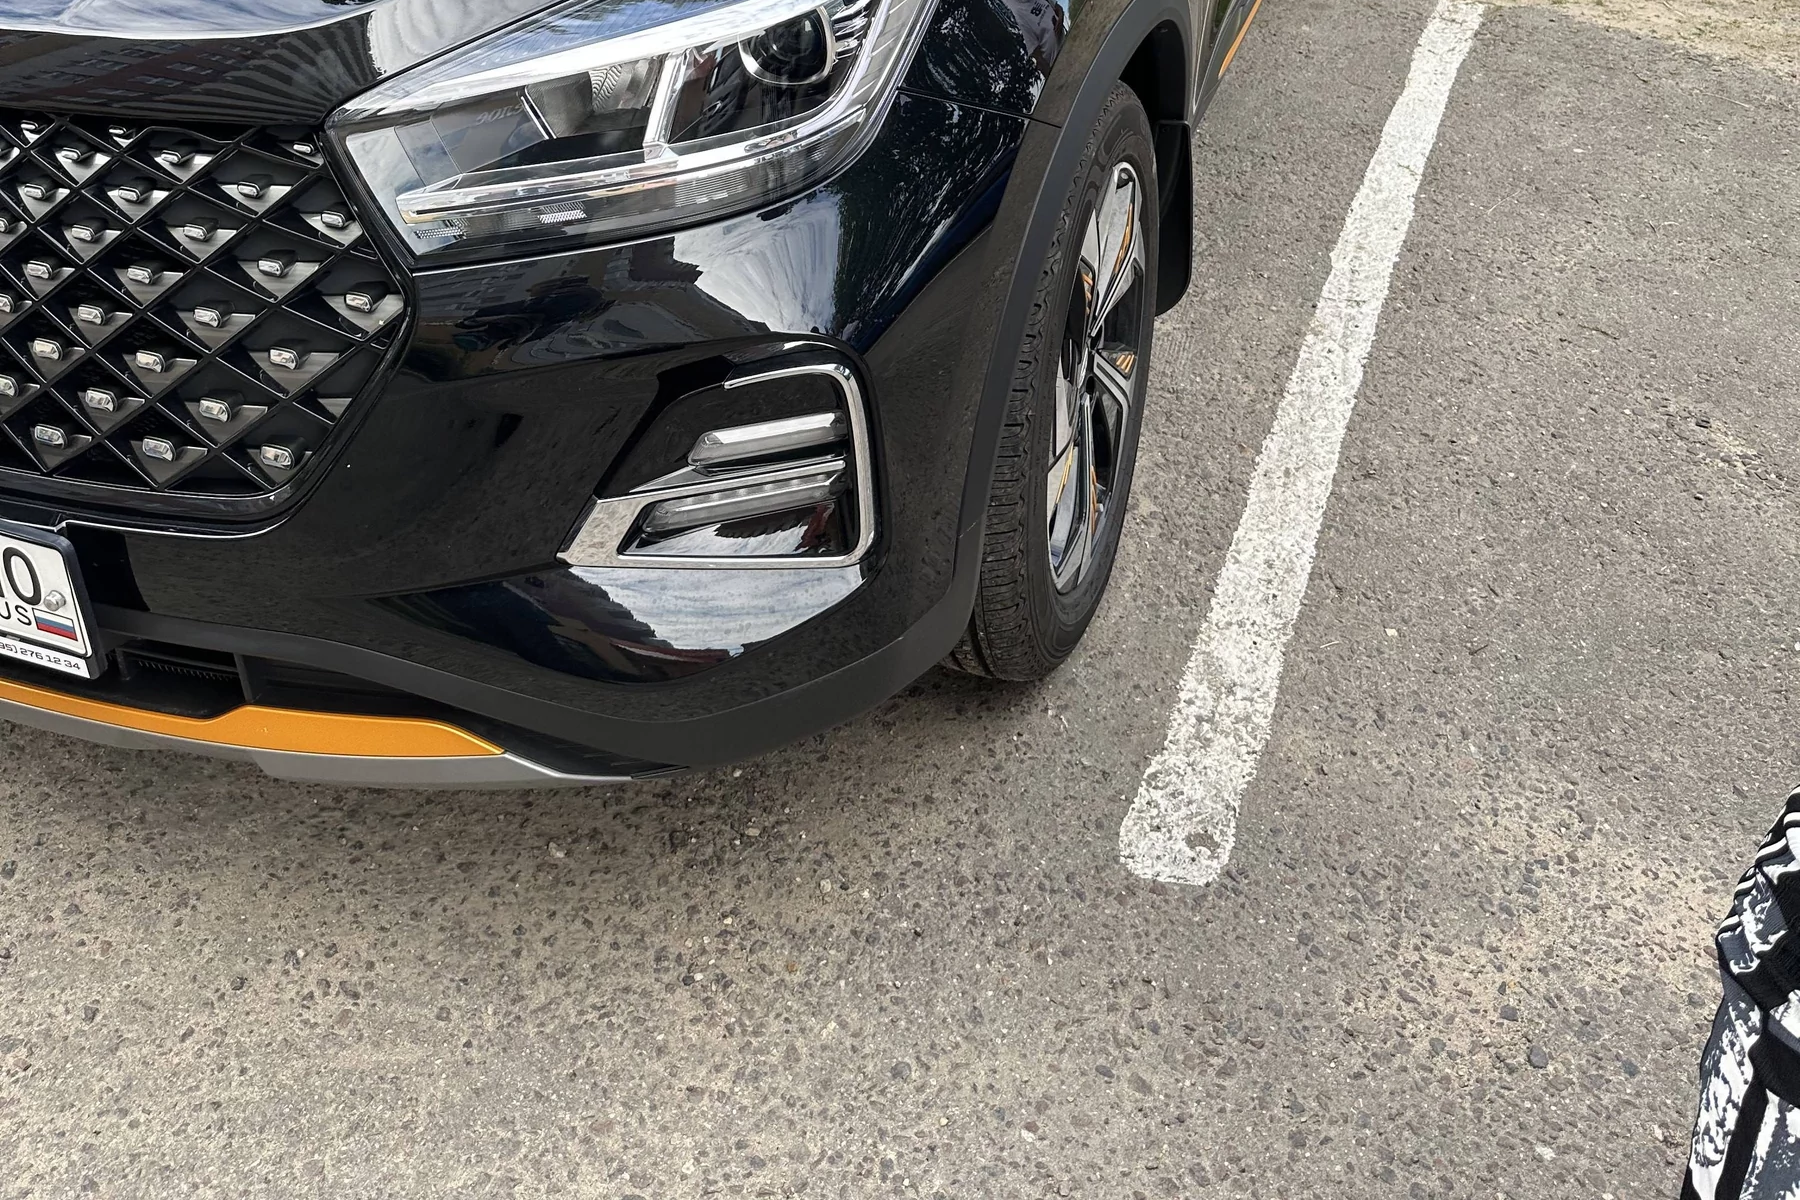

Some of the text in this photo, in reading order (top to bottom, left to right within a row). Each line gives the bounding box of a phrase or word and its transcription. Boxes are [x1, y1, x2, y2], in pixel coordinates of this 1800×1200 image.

[20, 647, 44, 660] 276
[45, 654, 62, 666] 12
[63, 659, 81, 670] 34
